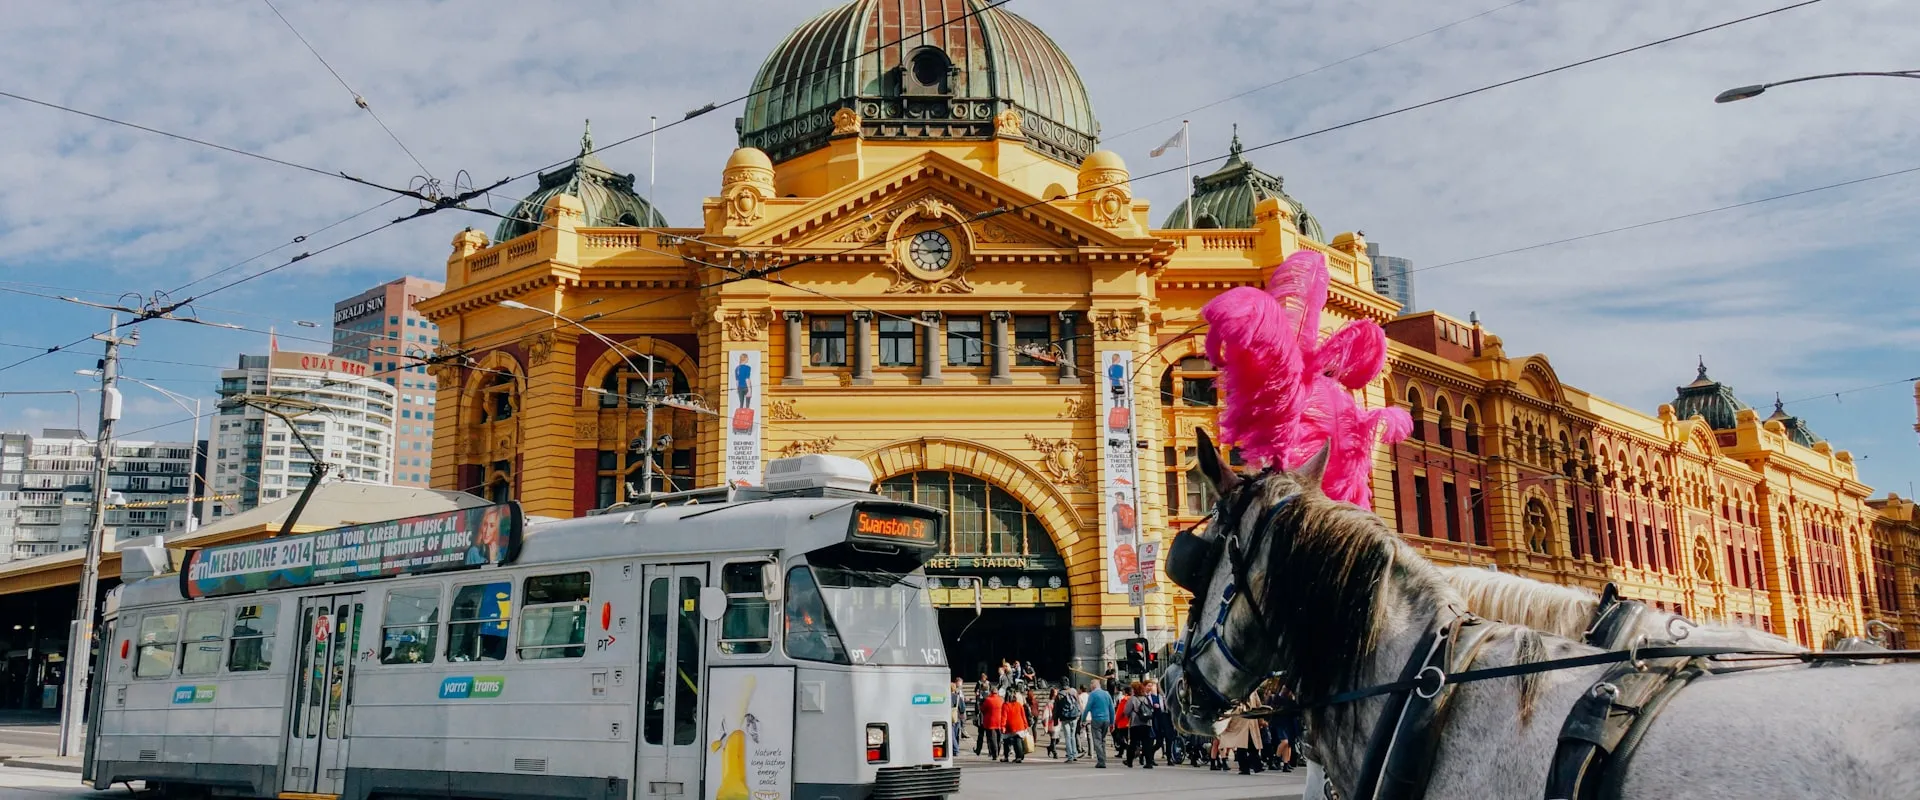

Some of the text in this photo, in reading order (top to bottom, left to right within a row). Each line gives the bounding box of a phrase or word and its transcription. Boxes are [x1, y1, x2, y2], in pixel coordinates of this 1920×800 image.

[366, 296, 384, 311] SUN
[301, 356, 365, 376] QUAY WEST
[316, 516, 458, 549] START YOUR CAREER IN MUSIC AT
[858, 512, 925, 539] Swanston St
[315, 531, 473, 564] THE AUSTRALIAN INSTITUTE OF MUSIC
[210, 546, 277, 574] MELBOURNE
[282, 542, 311, 564] 2014
[973, 557, 1027, 569] STATION
[852, 649, 865, 662] PT
[921, 648, 941, 664] 167
[444, 680, 499, 695] yarra trams
[754, 748, 782, 756] Nature's
[751, 758, 786, 770] long lasting
[757, 770, 778, 779] energy
[760, 778, 777, 786] snack
